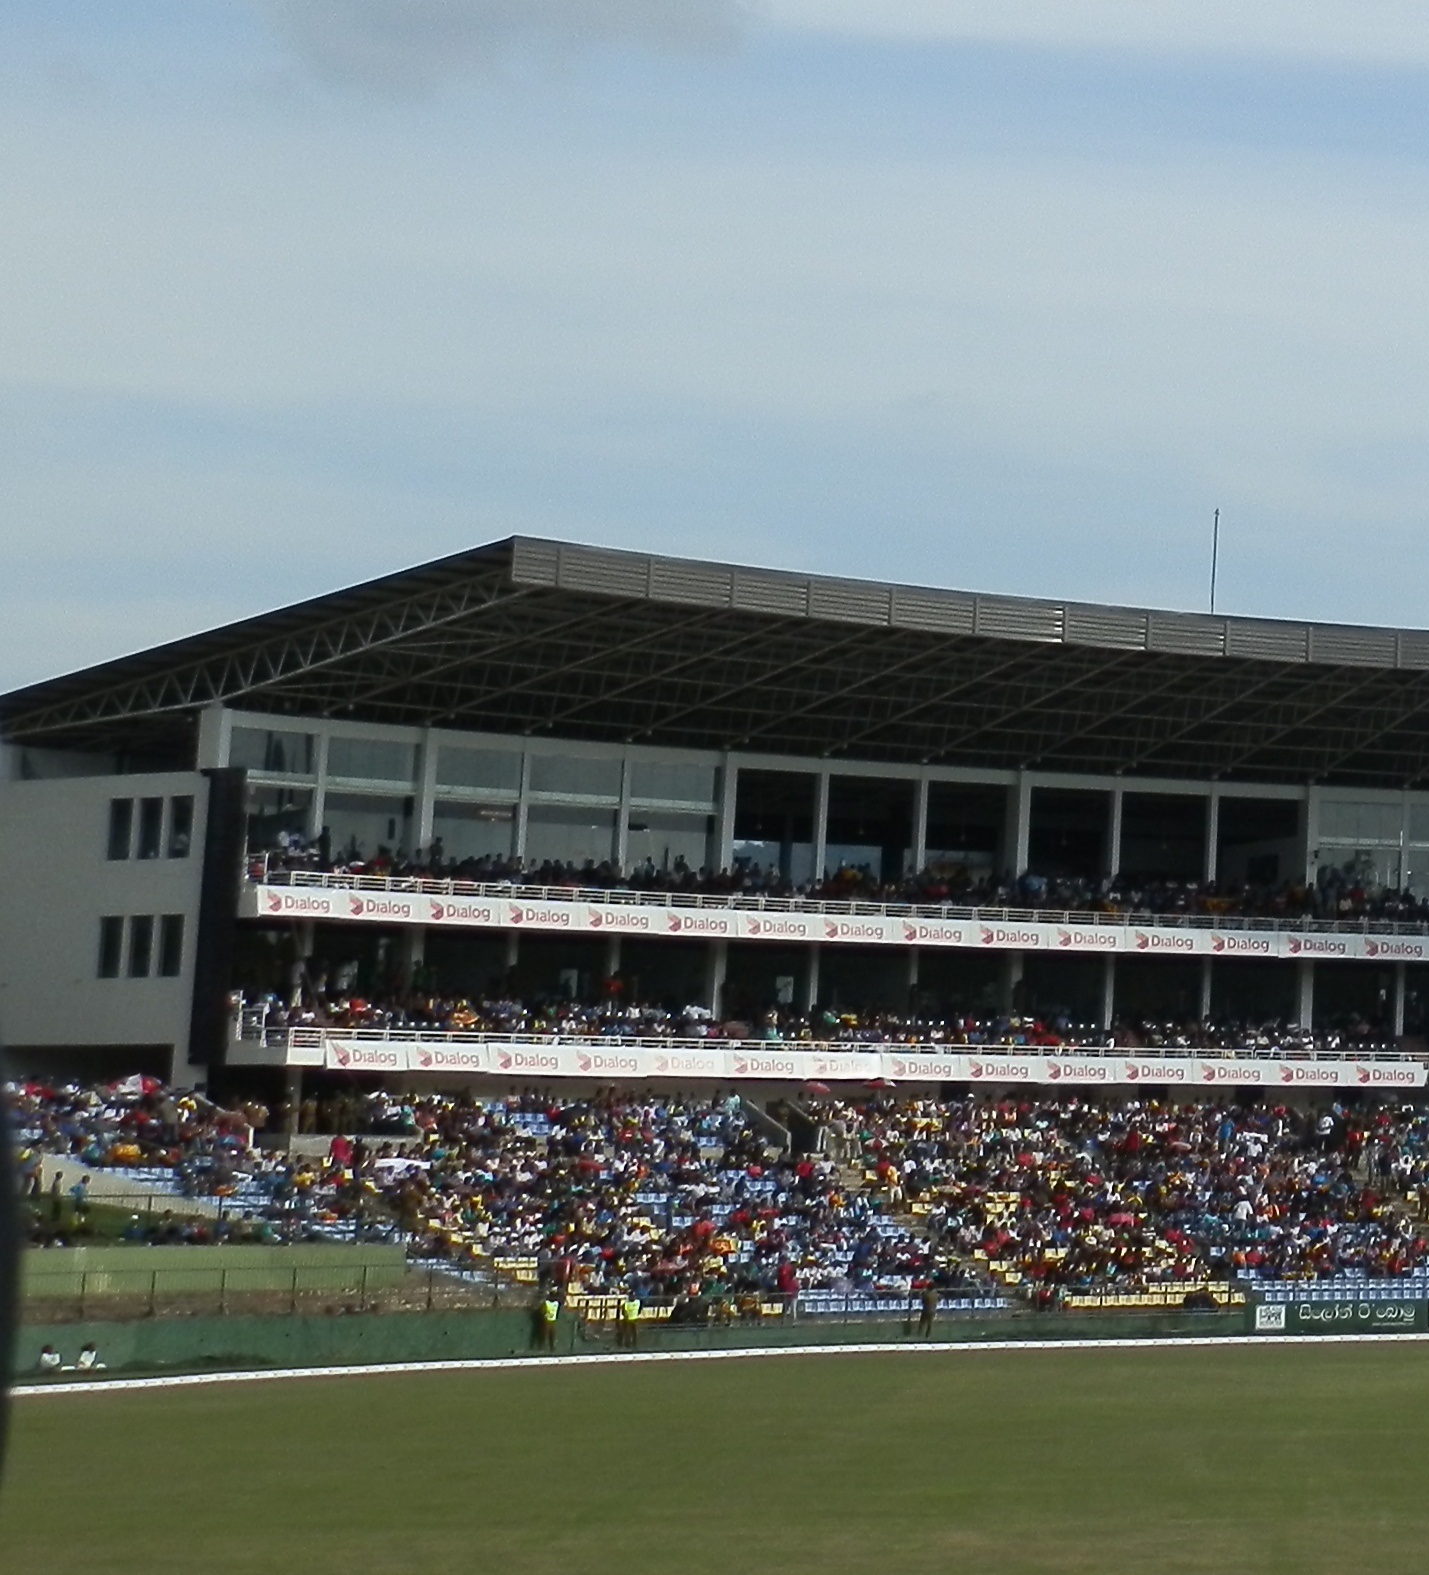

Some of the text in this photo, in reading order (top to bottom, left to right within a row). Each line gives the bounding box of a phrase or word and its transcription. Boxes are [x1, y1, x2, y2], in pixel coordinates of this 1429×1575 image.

[285, 895, 330, 913] Dialog
[367, 899, 410, 918] Dialog
[447, 904, 490, 922] Dialog
[526, 908, 569, 926] Dialog
[605, 912, 648, 929] Dialog
[684, 917, 727, 933] Dialog
[763, 920, 806, 936] Dialog
[841, 923, 883, 939] Dialog
[920, 926, 962, 942] Dialog
[997, 930, 1039, 945] Dialog
[1074, 932, 1116, 947] Dialog
[1152, 935, 1193, 950] Dialog
[1227, 937, 1269, 952] Dialog
[1304, 939, 1346, 954] Dialog
[1381, 942, 1423, 957] Dialog
[353, 1049, 397, 1066] Dialog
[435, 1051, 479, 1068] Dialog
[515, 1053, 558, 1069] Dialog
[594, 1055, 637, 1071] Dialog
[671, 1057, 714, 1072] Dialog
[751, 1058, 794, 1074] Dialog
[909, 1062, 951, 1077] Dialog
[986, 1063, 1028, 1078] Dialog
[1064, 1064, 1106, 1080] Dialog
[1142, 1065, 1184, 1080] Dialog
[1218, 1067, 1260, 1082] Dialog
[1296, 1068, 1338, 1083] Dialog
[1373, 1069, 1414, 1083] Dialog
